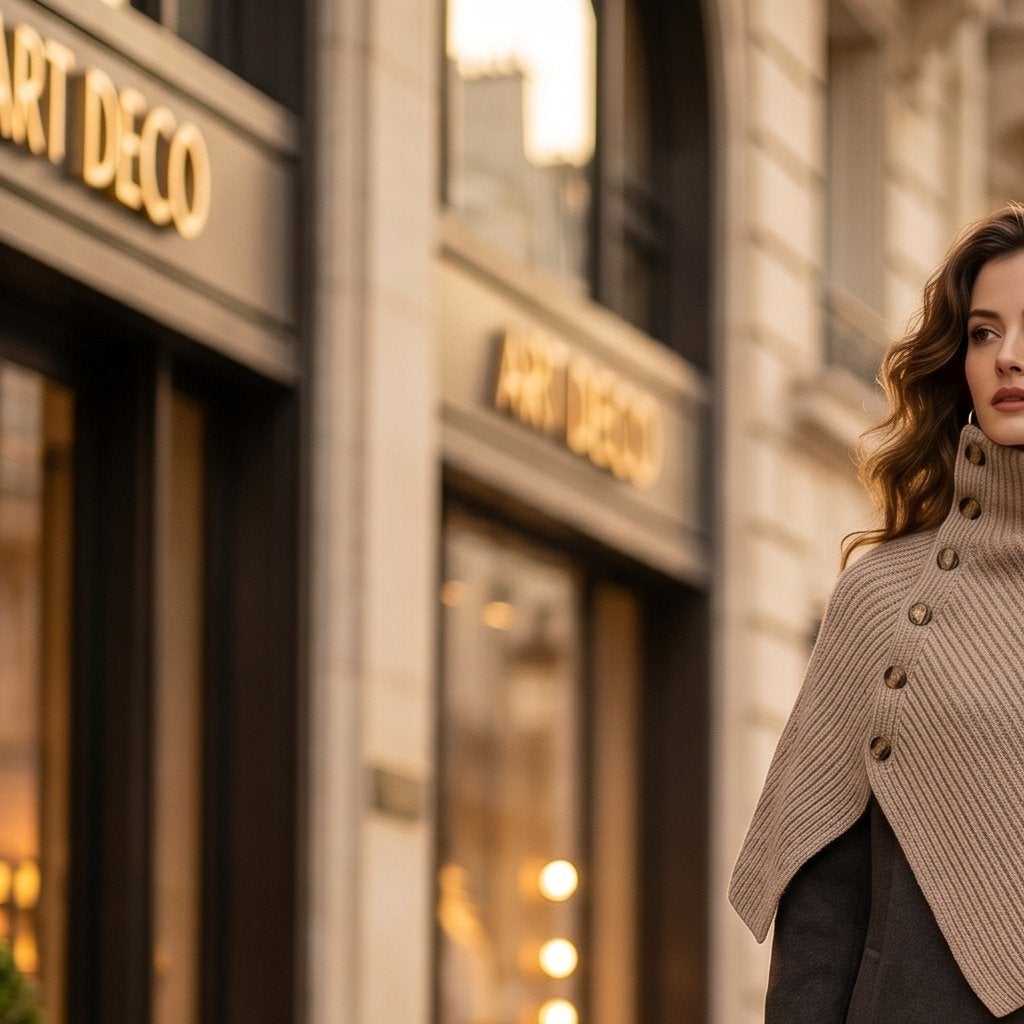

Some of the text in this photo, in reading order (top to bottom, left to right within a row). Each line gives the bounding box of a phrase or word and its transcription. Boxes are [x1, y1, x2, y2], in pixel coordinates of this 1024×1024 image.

[84, 68, 211, 240] DECO
[495, 328, 664, 489] ART DECO
